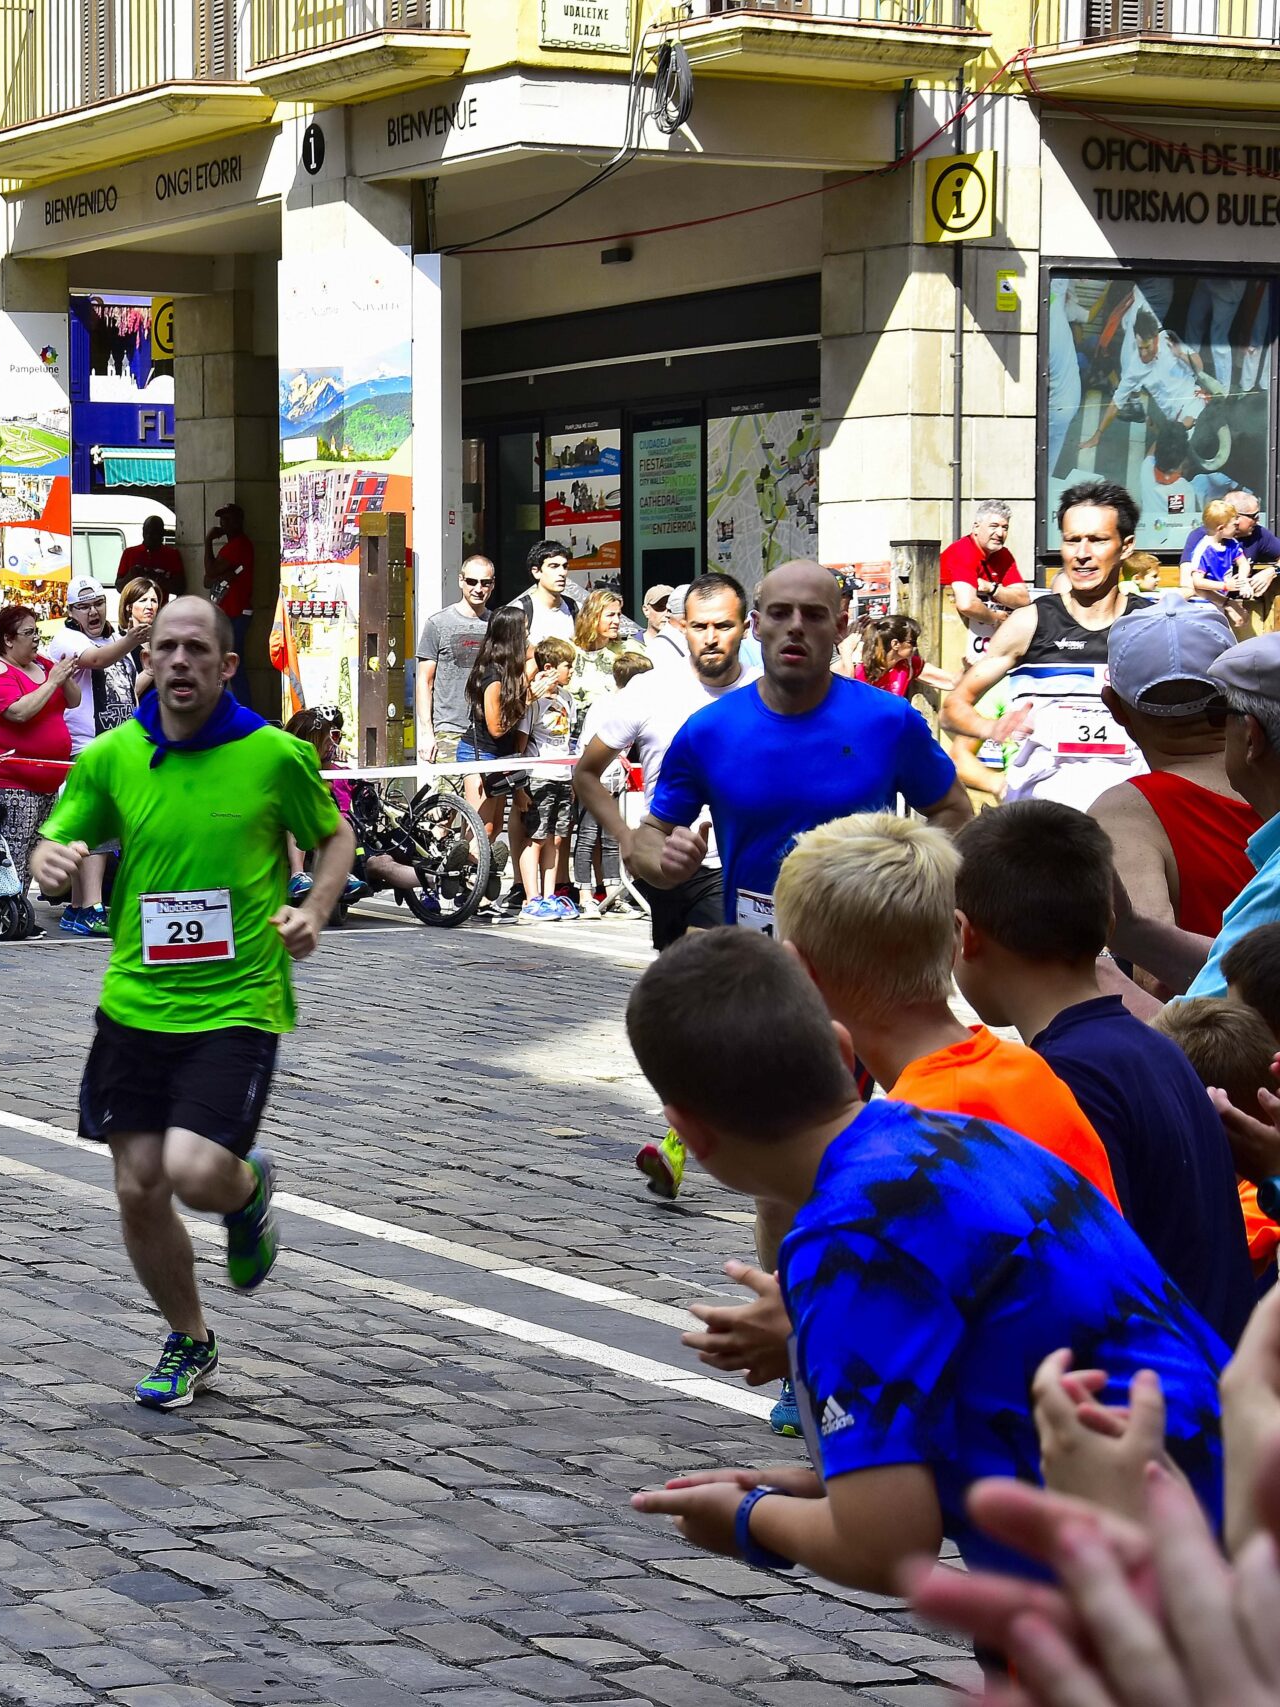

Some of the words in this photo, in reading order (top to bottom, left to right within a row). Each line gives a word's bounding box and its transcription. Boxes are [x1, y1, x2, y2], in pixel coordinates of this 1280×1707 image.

[563, 4, 609, 21] UDALETXE
[573, 22, 601, 38] PLAZA
[386, 97, 478, 148] BIENVENUE
[1081, 136, 1196, 174] OFICINA
[1202, 142, 1238, 176] DE
[154, 171, 193, 202] ONGI
[196, 154, 242, 192] ETORRI
[44, 185, 119, 226] BIENVENIDO
[1093, 187, 1210, 224] TURISMO
[9, 364, 60, 375] Pampelune
[639, 458, 664, 472] FIESTA
[640, 494, 680, 508] CATHEDRAL
[99, 703, 135, 718] STA
[1078, 725, 1107, 743] 34
[159, 902, 205, 913] Noticias
[167, 920, 204, 944] 29
